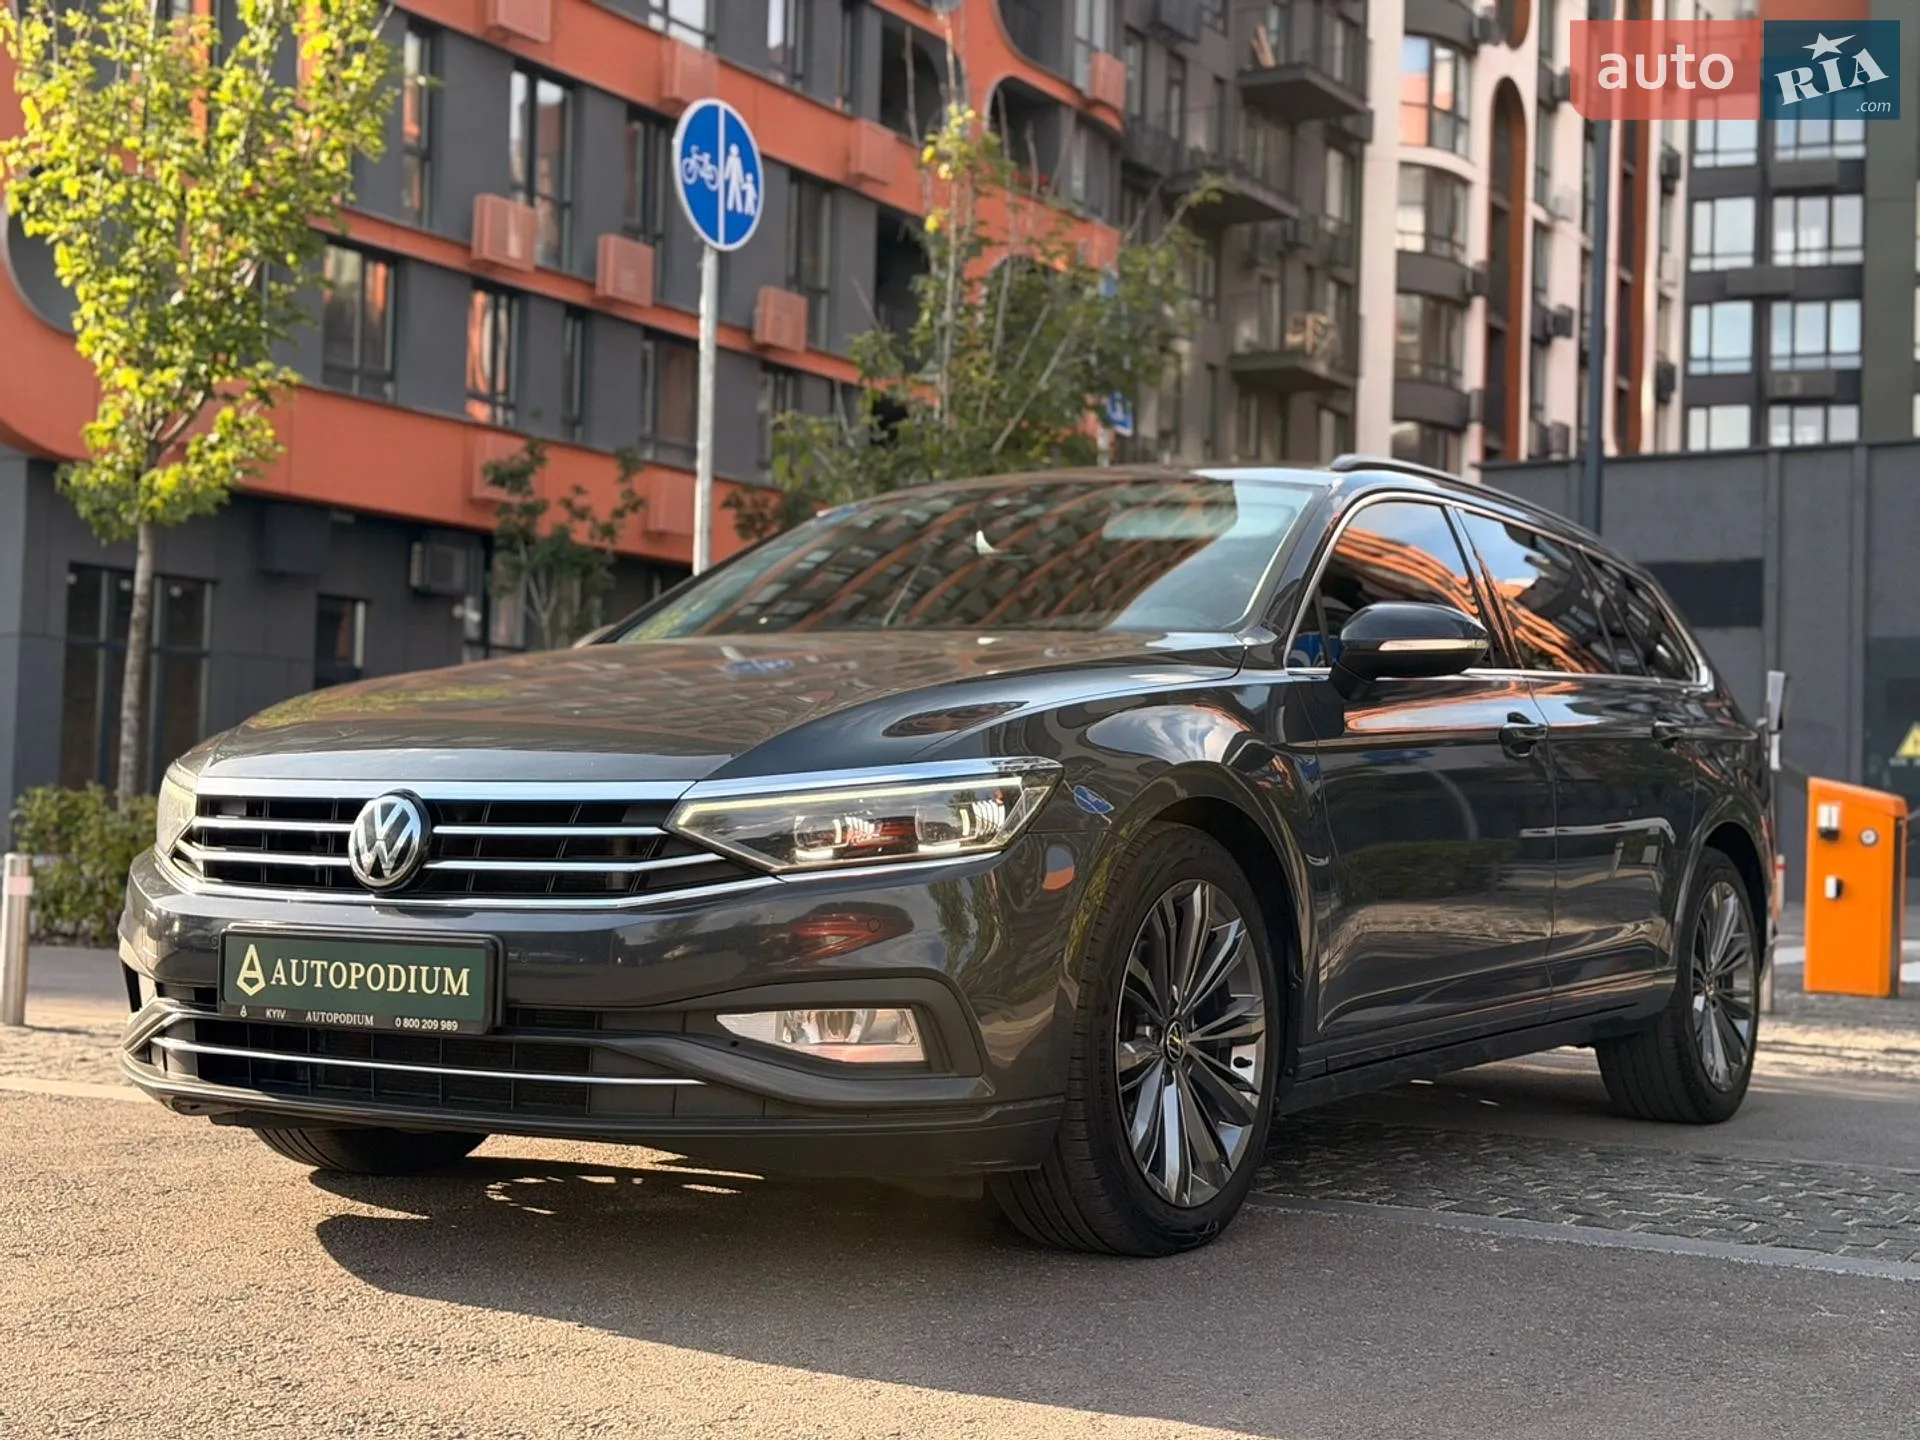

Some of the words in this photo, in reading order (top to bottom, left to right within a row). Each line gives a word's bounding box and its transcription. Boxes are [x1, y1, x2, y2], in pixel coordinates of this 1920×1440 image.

[270, 958, 470, 996] AUTOPODIUM
[265, 1008, 287, 1020] KYIV
[305, 1010, 375, 1026] AUTOPODIUM
[394, 1017, 401, 1028] 0
[402, 1017, 420, 1029] 800
[421, 1018, 439, 1030] 209
